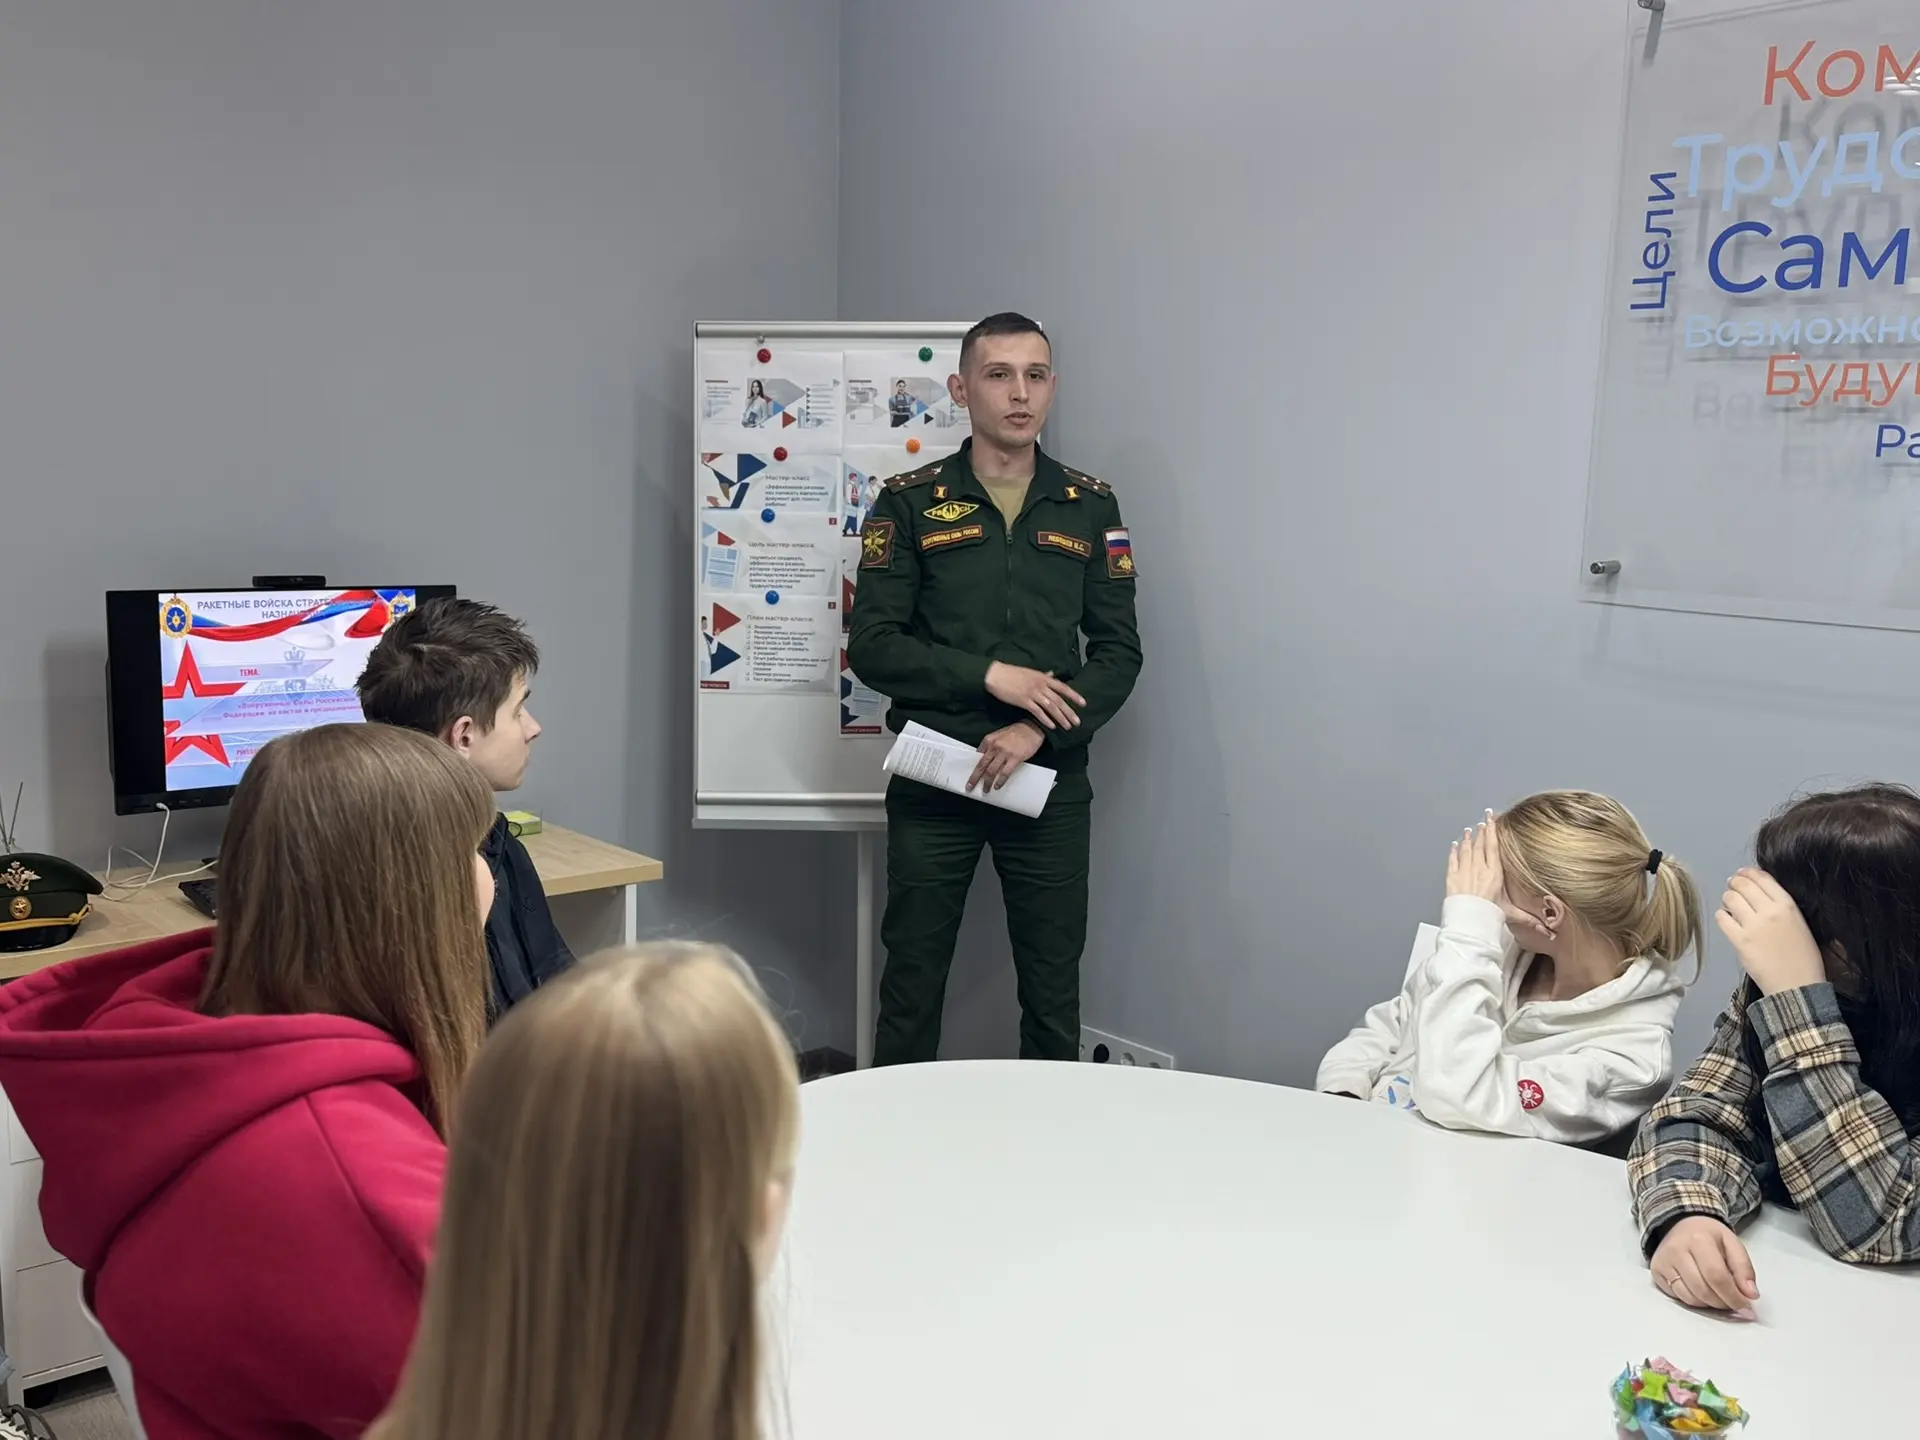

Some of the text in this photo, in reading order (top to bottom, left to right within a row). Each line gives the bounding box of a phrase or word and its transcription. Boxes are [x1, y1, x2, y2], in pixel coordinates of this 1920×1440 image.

[1630, 171, 1677, 310] Цели
[1708, 221, 1910, 294] Сам
[1765, 354, 1920, 407] Буду
[197, 599, 250, 609] РАКЕТНЫЕ
[253, 598, 294, 609] ВОЙСКА
[239, 668, 260, 677] ТЕМА:
